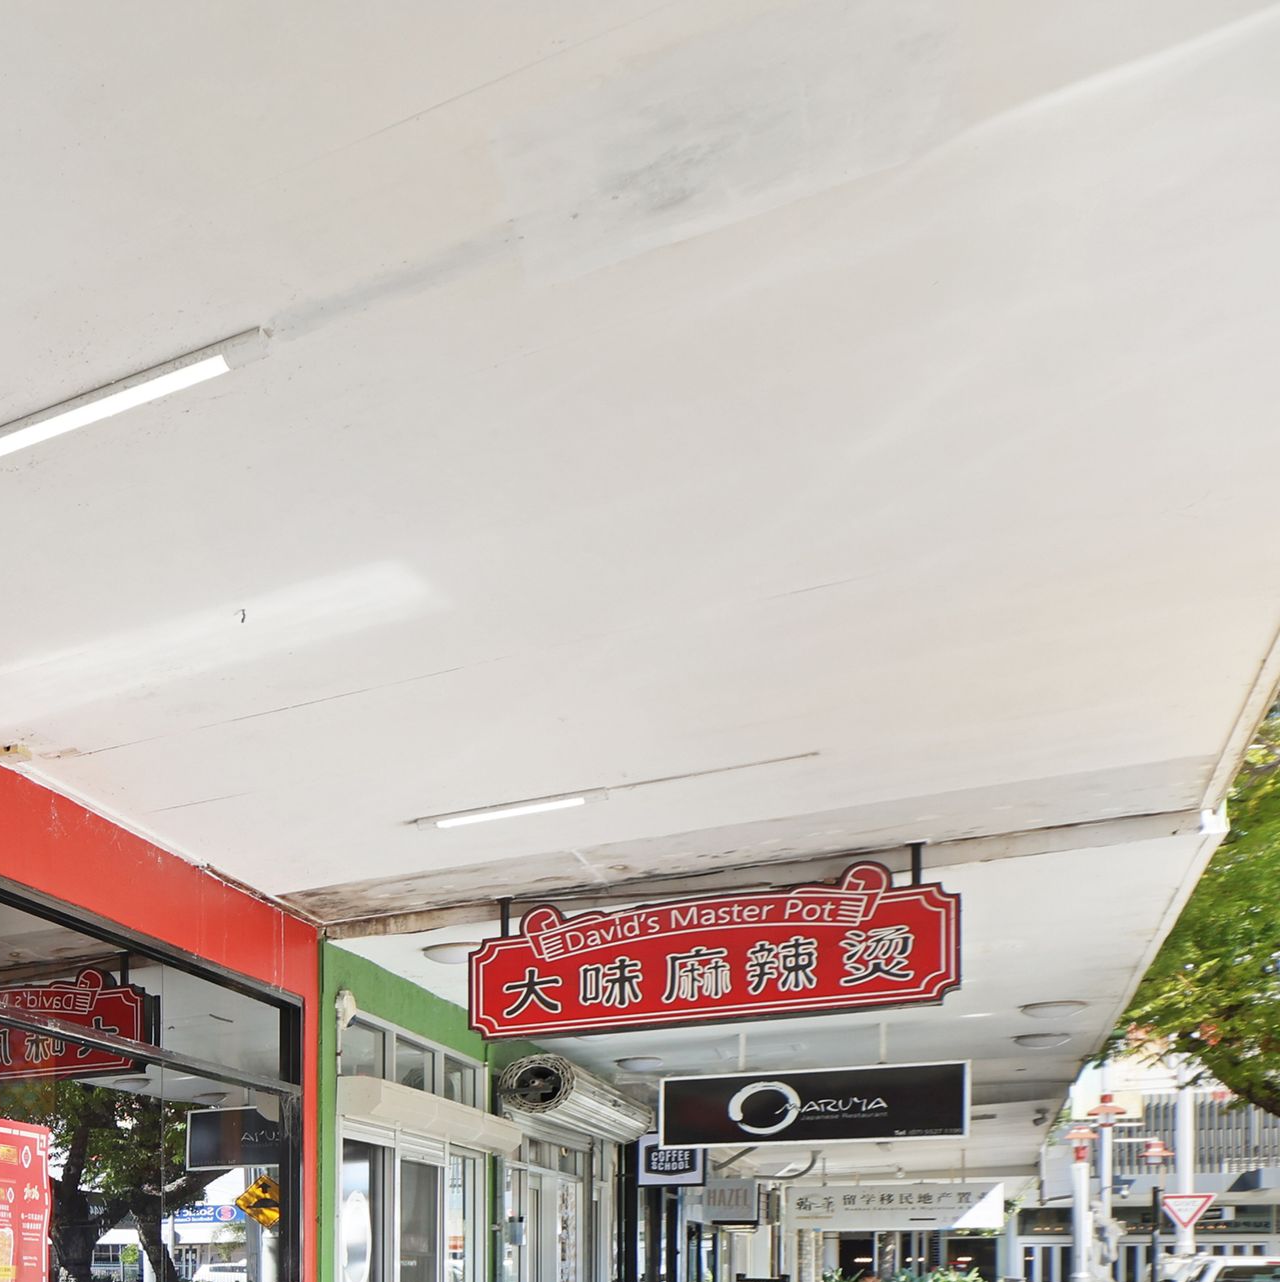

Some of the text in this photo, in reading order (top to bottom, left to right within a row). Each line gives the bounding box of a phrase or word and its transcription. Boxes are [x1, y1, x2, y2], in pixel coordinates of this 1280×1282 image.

[566, 900, 836, 953] David's Master Pot
[503, 925, 914, 1017] 大味麻辣烫
[651, 1150, 690, 1162] COFFEE
[651, 1161, 690, 1171] SCHOOL
[707, 1188, 752, 1207] HAZEL
